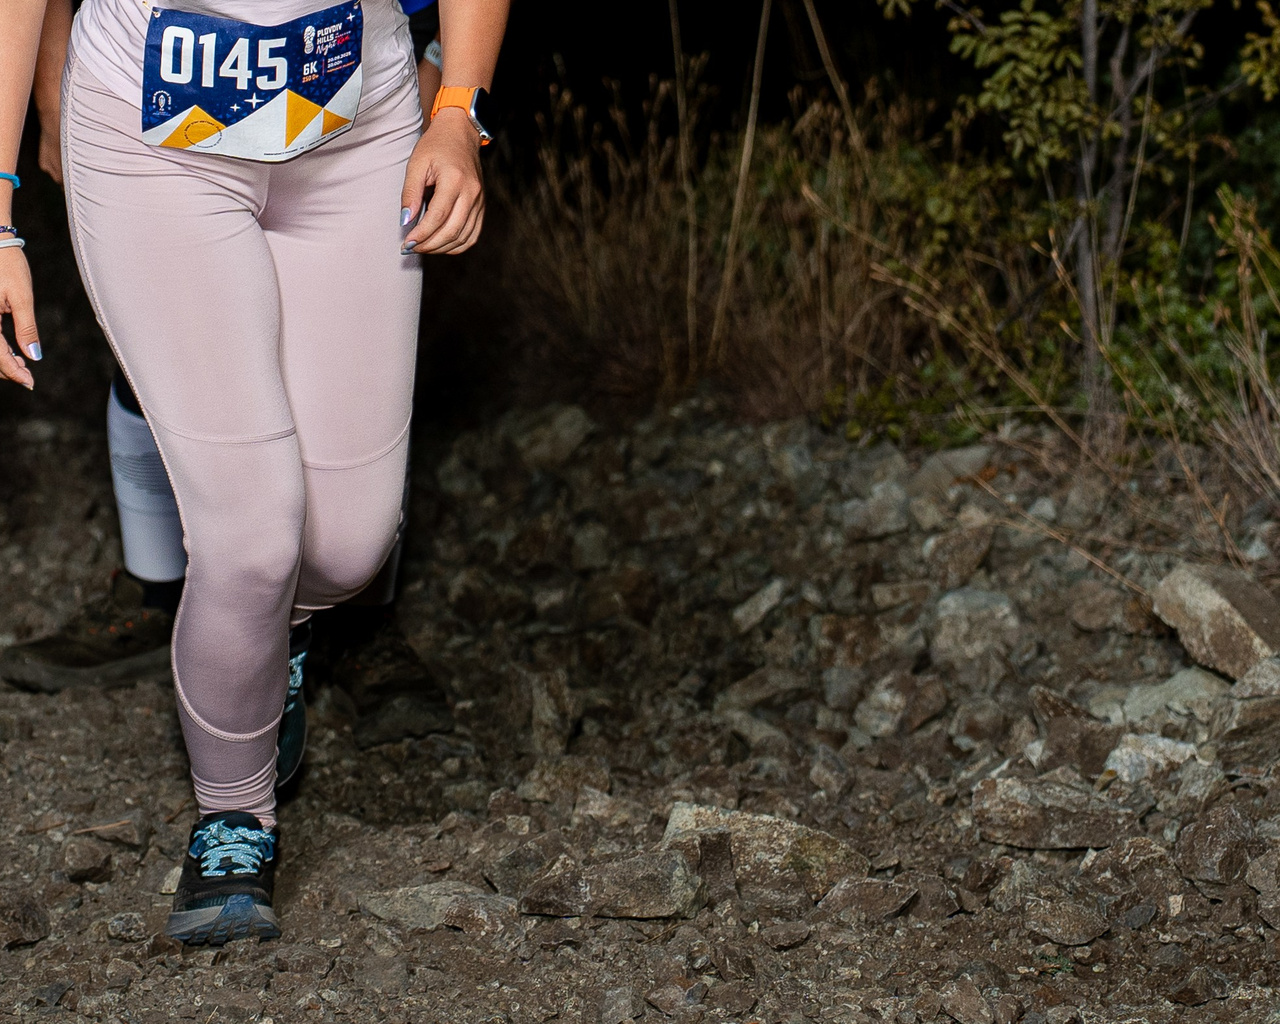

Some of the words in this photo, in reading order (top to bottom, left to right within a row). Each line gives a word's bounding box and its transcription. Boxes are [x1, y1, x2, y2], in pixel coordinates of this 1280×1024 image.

[317, 22, 343, 37] PLOVDIV
[316, 33, 334, 45] HILLS
[316, 39, 337, 56] Night
[160, 25, 288, 90] 0145
[303, 60, 318, 76] 6K
